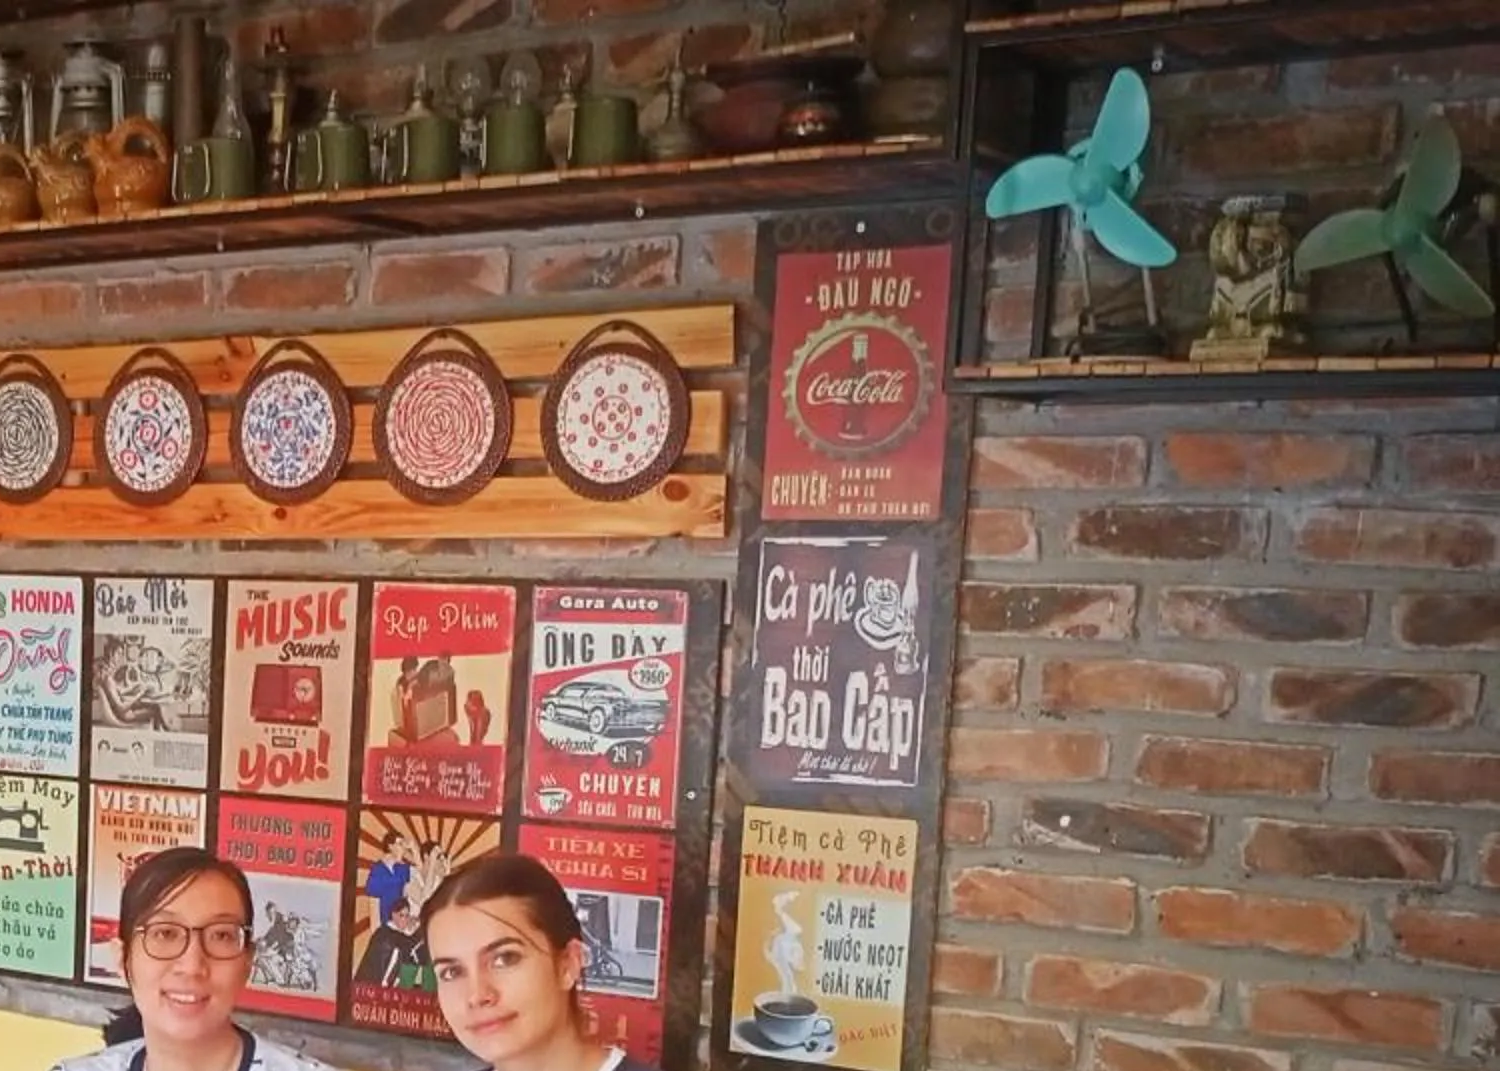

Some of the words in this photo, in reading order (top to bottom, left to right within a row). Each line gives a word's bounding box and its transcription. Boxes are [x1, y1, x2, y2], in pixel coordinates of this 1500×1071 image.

[11, 588, 75, 616] HONDA
[559, 595, 605, 609] Gara
[611, 595, 660, 611] Auto
[763, 564, 799, 623] Cà
[805, 566, 857, 637] phê
[236, 587, 349, 651] MUSIC
[438, 601, 500, 634] Phim
[792, 643, 830, 683] thời
[32, 778, 76, 809] May
[612, 841, 646, 859] XE
[748, 819, 808, 851] Tiệm
[819, 828, 845, 851] cà
[742, 852, 826, 883] THANH
[835, 860, 908, 895] XUÂN
[855, 973, 892, 1001] KHÁT
